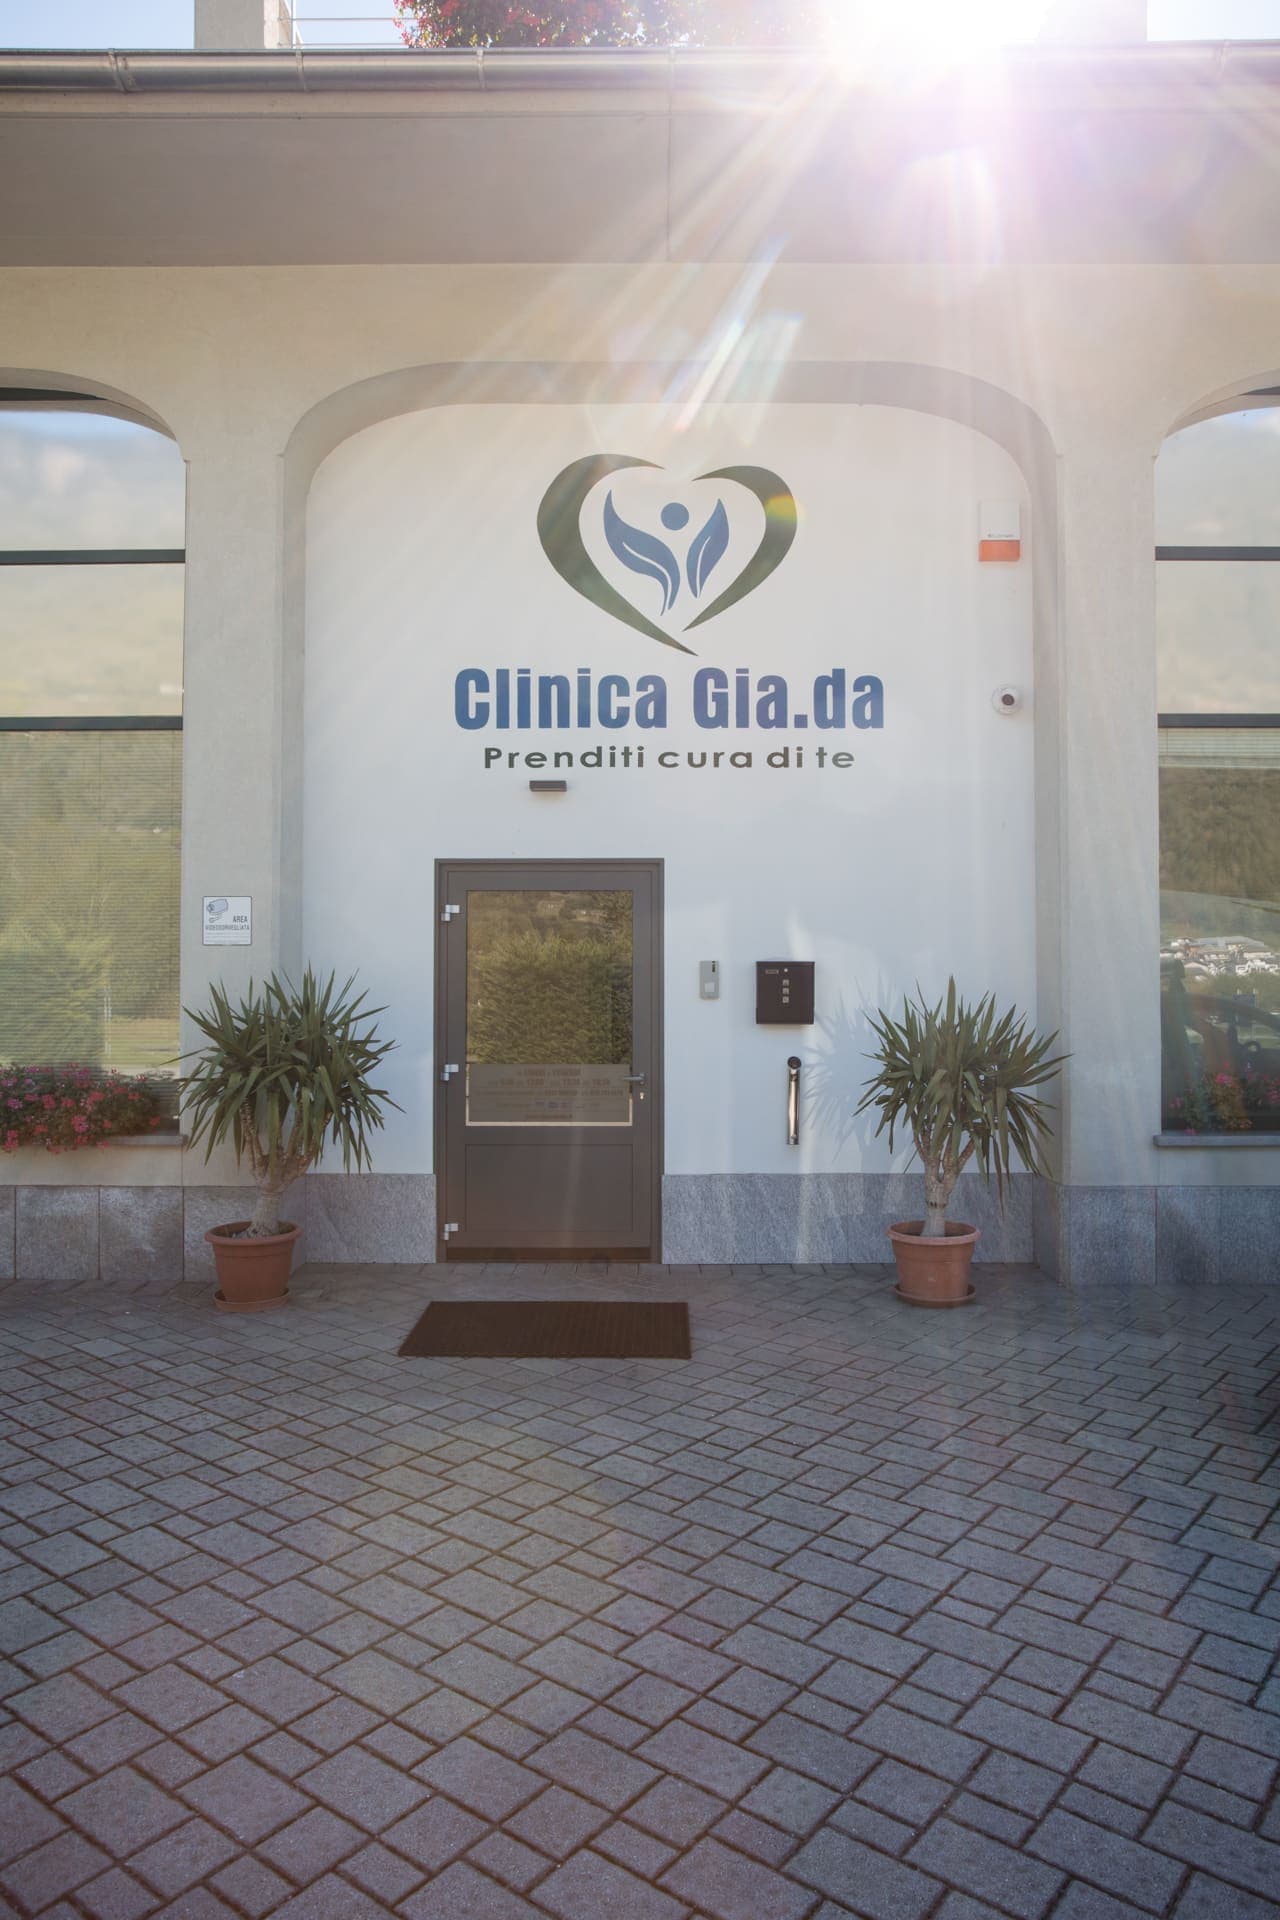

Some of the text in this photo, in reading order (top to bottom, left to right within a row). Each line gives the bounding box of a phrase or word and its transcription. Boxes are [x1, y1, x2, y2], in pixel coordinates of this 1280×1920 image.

[455, 667, 884, 730] Clinica Gia.da
[485, 745, 644, 768] Prenditi
[658, 752, 752, 768] cura
